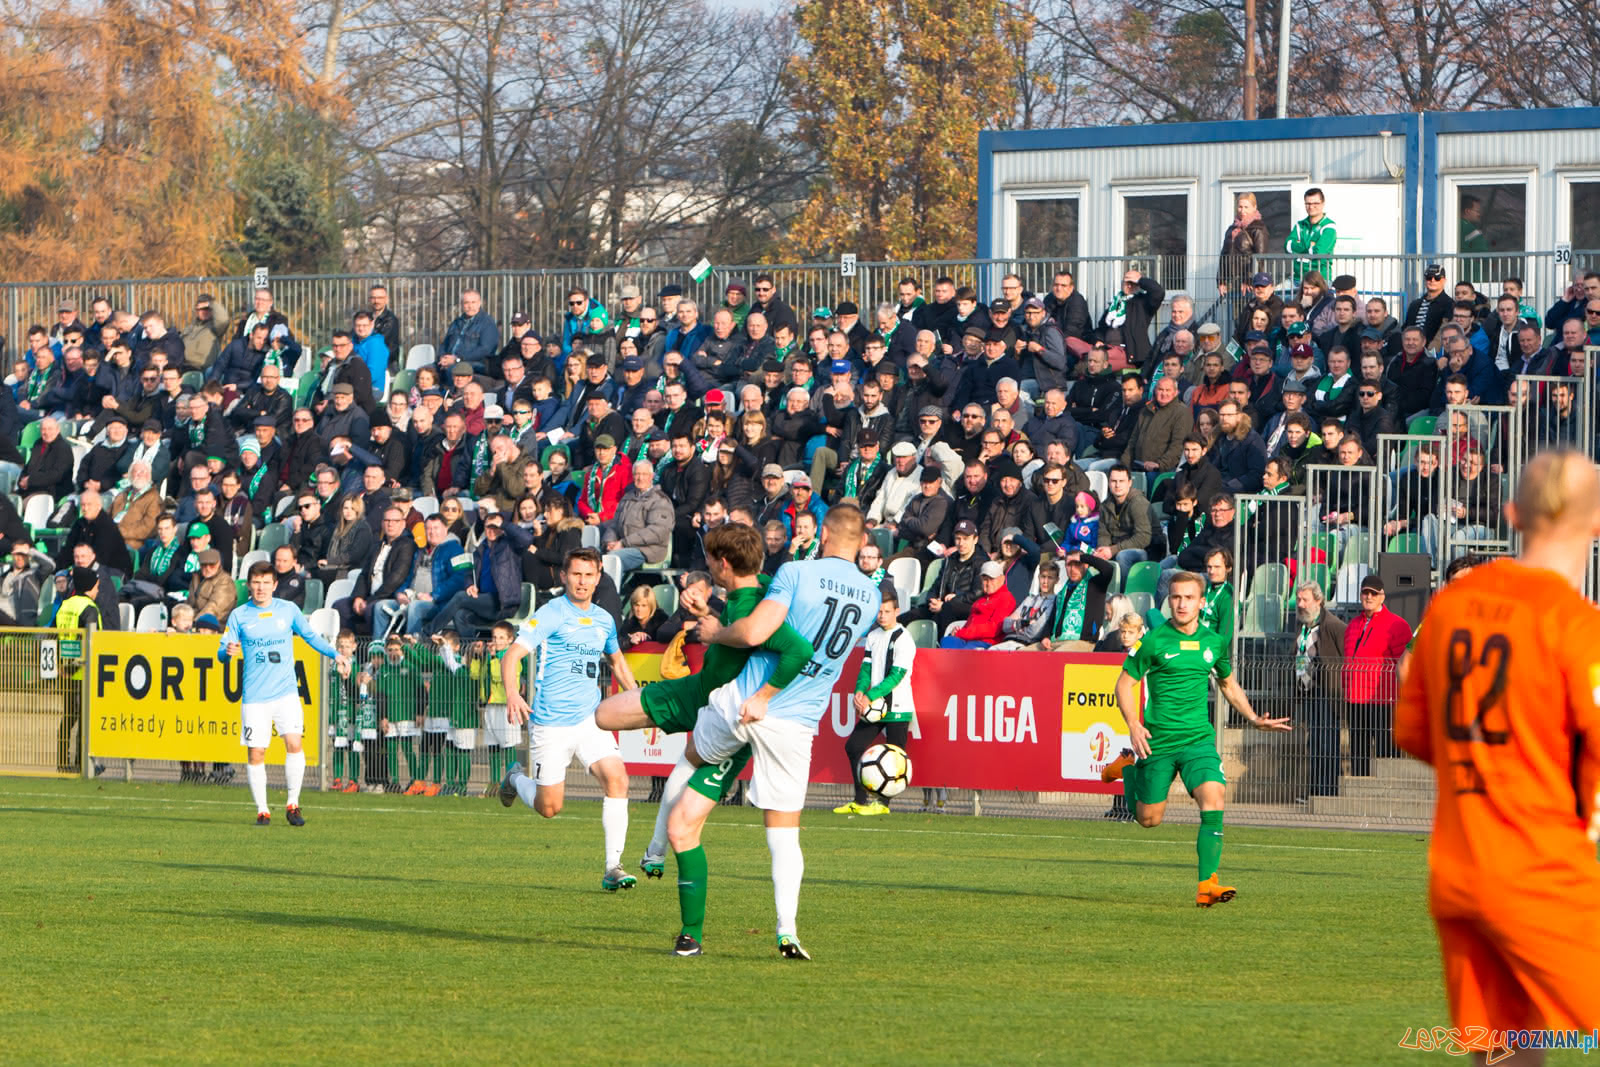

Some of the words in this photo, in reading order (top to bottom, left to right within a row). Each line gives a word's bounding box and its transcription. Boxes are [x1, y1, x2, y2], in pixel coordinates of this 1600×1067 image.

[843, 261, 854, 273] 31
[1555, 249, 1570, 262] 30
[255, 274, 267, 285] 32
[820, 578, 872, 604] SOŁOWIEJ
[812, 596, 862, 660] 16
[41, 647, 55, 671] 33
[97, 654, 312, 705] FORTUA
[1447, 629, 1512, 745] 82
[1067, 692, 1120, 708] FORTU
[100, 713, 166, 738] zakłady
[944, 694, 958, 741] 1
[967, 695, 1038, 744] LIGA
[648, 748, 662, 757] LIGA
[712, 758, 733, 781] 9
